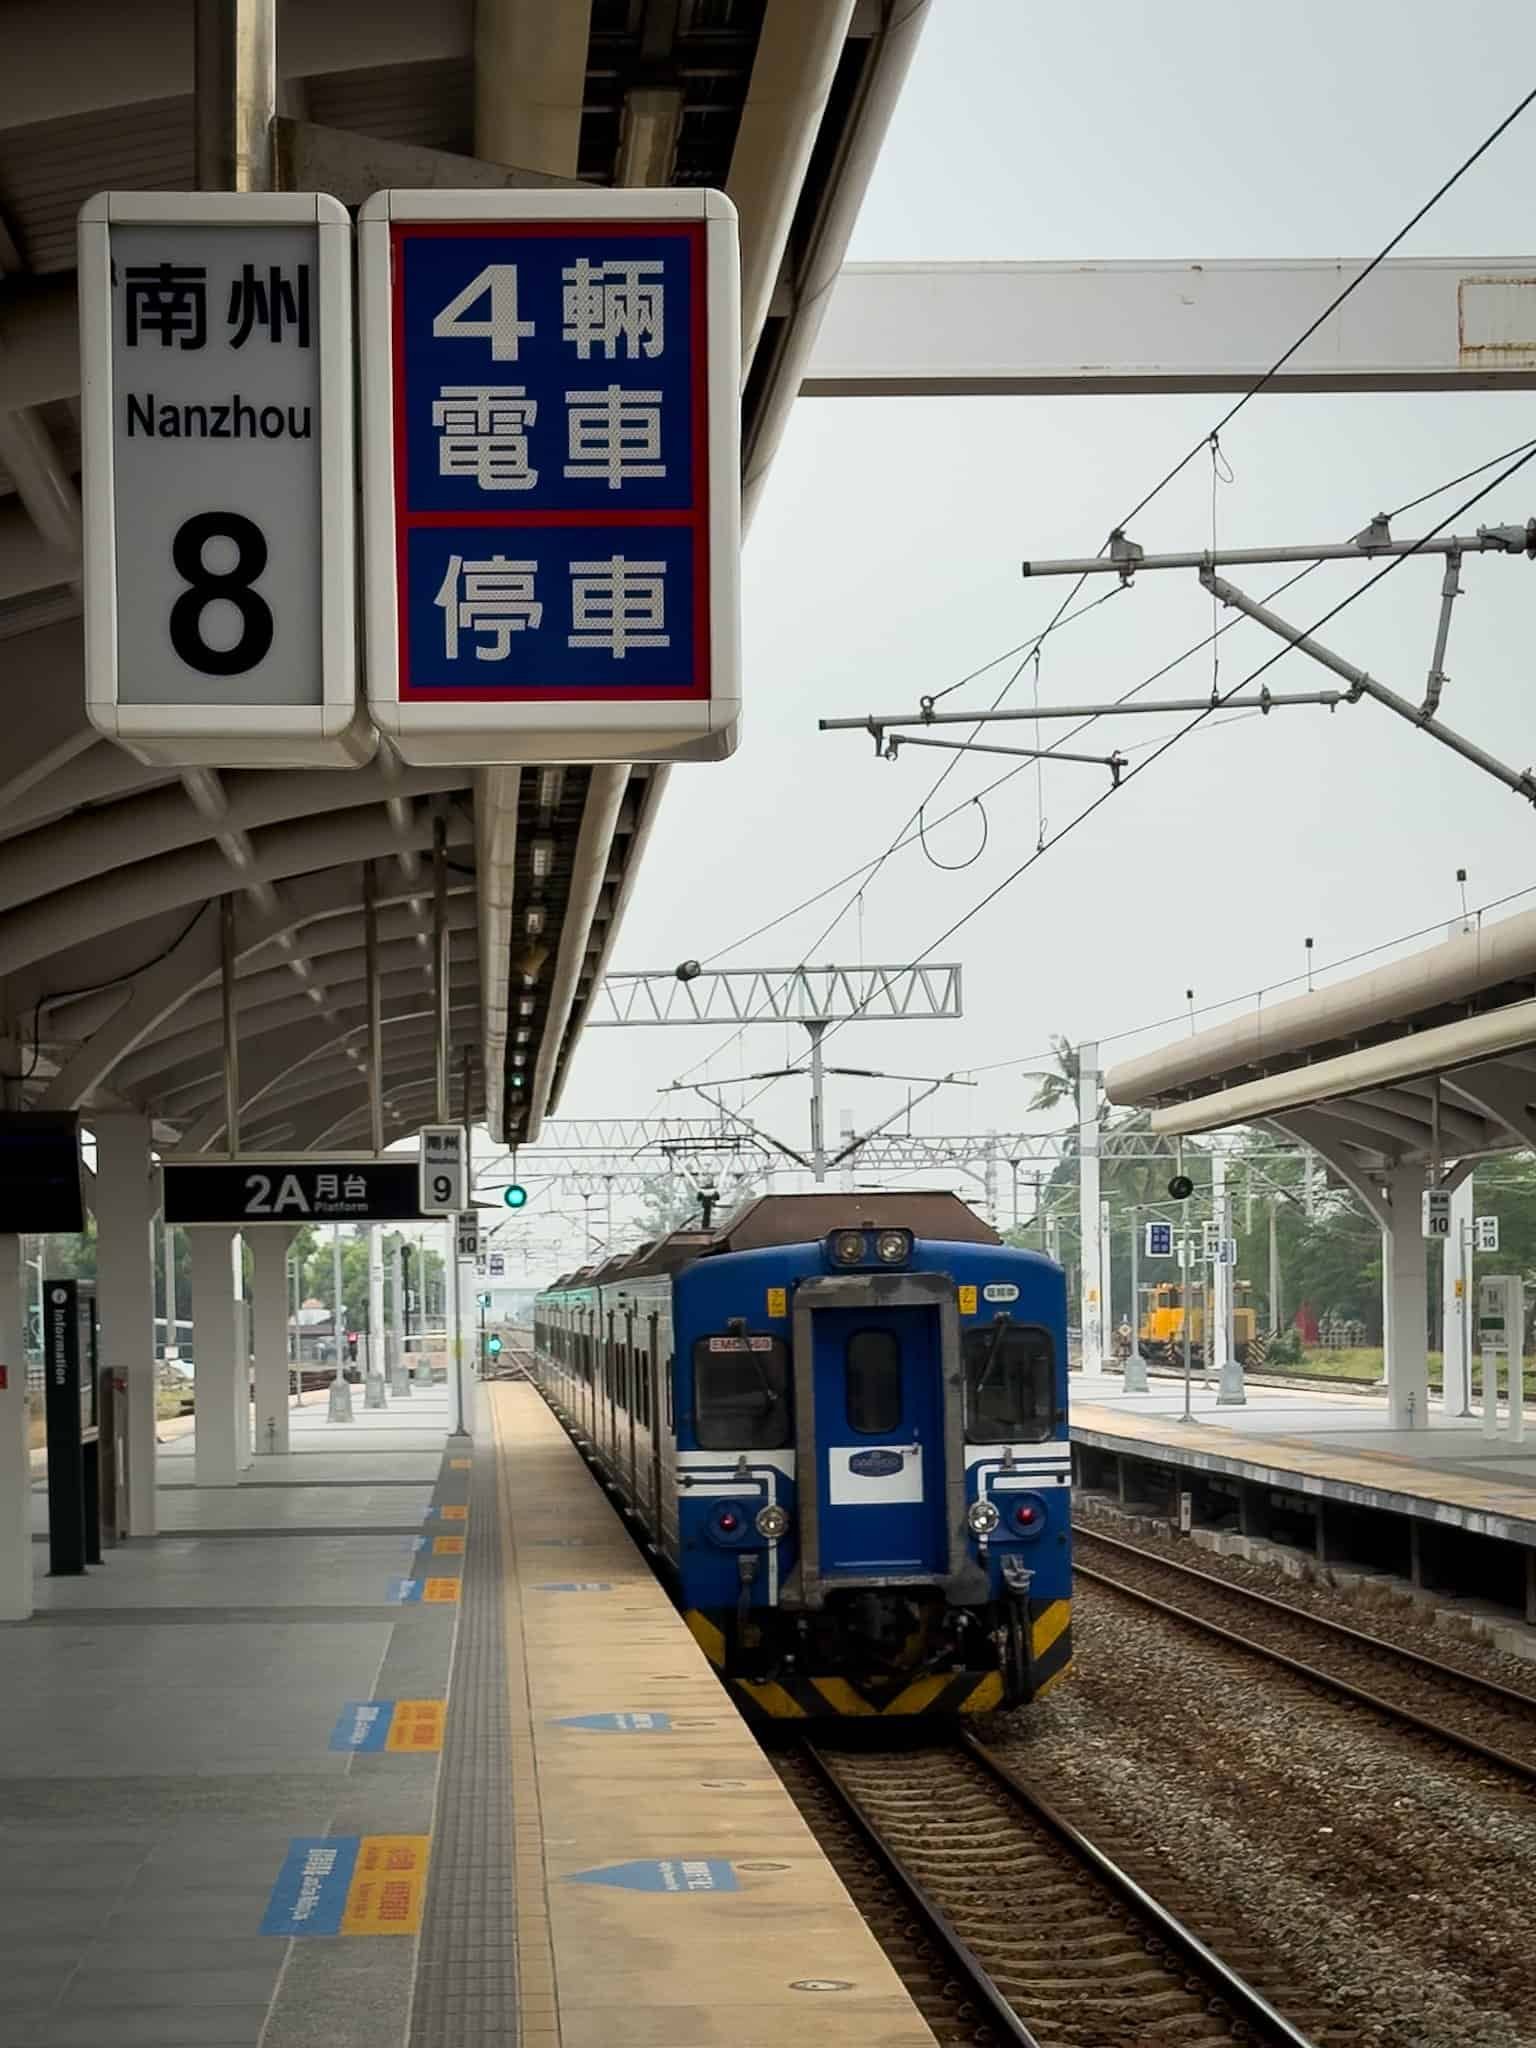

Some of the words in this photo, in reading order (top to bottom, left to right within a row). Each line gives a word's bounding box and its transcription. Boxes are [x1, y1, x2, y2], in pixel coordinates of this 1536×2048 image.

[125, 263, 310, 350] 南州
[433, 258, 665, 361] 4輛
[127, 393, 311, 438] Nanzhou
[432, 384, 667, 490] 電車
[169, 511, 274, 675] 8
[434, 555, 670, 661] 停車
[244, 1174, 310, 1213] 2A
[315, 1174, 366, 1199] 月台
[433, 1175, 452, 1203] 9
[458, 1236, 477, 1254] 10
[1430, 1217, 1449, 1233] 10
[1483, 1236, 1496, 1248] 10
[55, 1308, 66, 1385] Information
